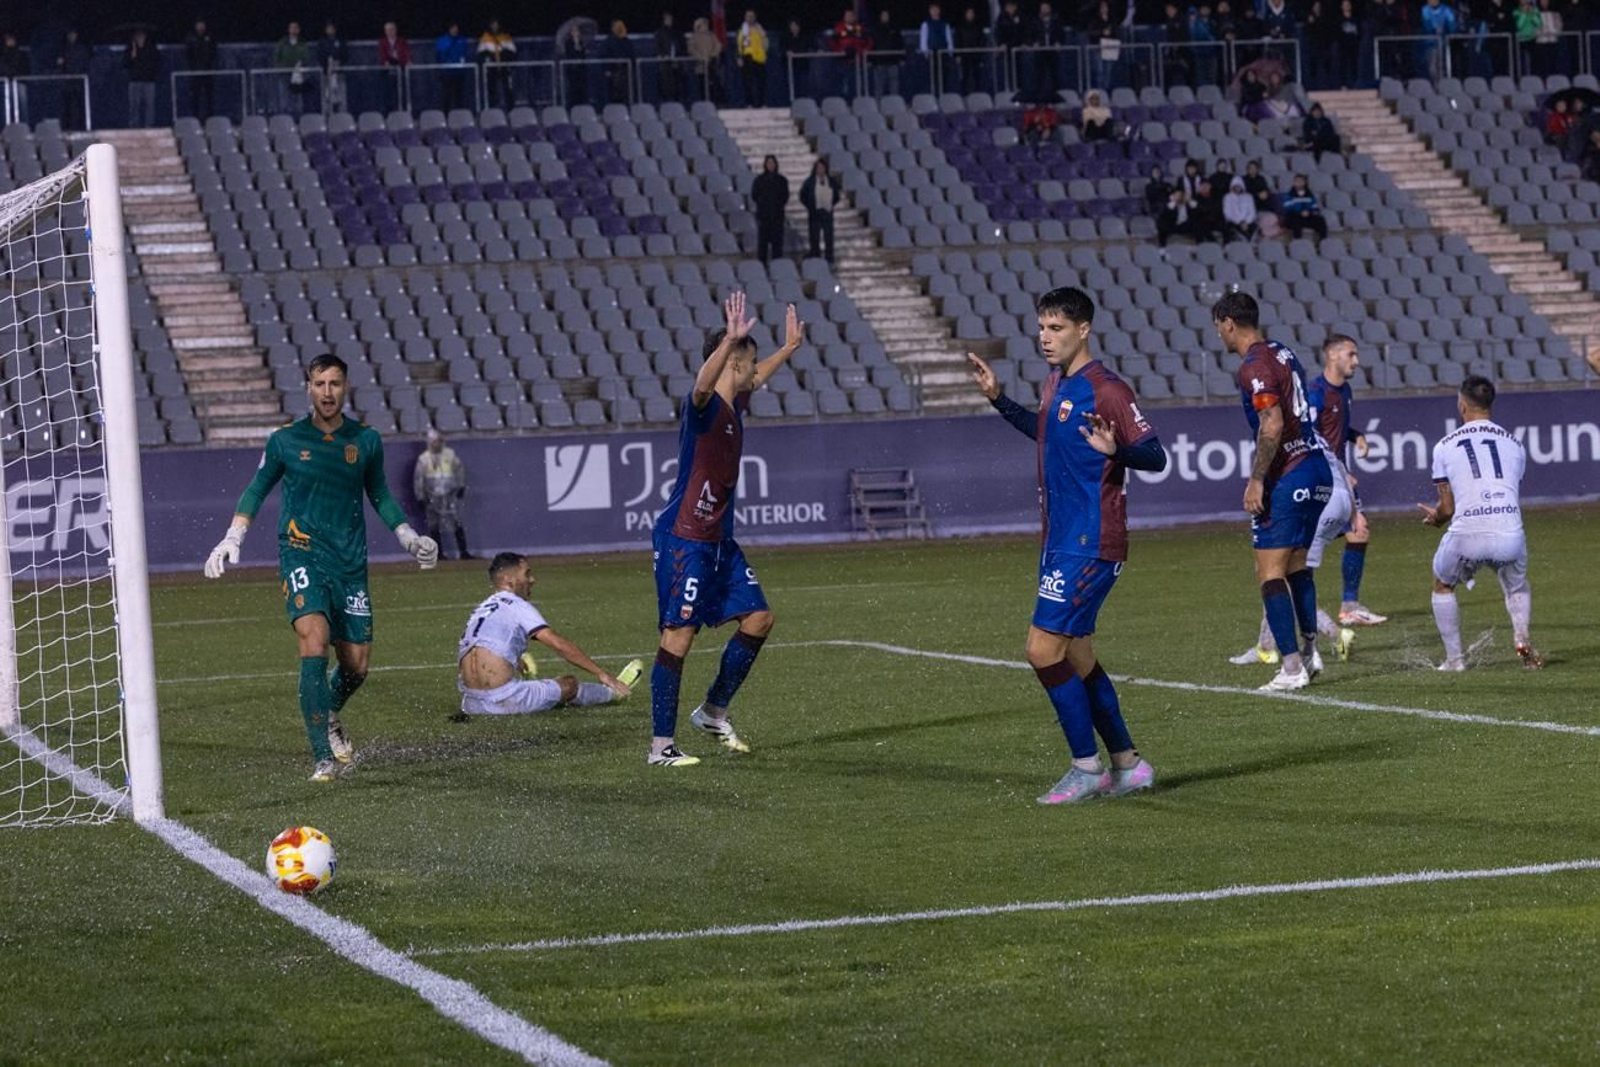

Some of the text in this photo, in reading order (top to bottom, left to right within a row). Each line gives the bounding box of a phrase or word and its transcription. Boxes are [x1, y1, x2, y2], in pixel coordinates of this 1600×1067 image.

[1122, 433, 1256, 492] otor
[1345, 418, 1428, 473] én
[1456, 438, 1504, 479] 11
[620, 442, 768, 507] Jan
[733, 502, 827, 526] NTERIOR
[290, 567, 310, 593] 13
[683, 577, 699, 601] 5
